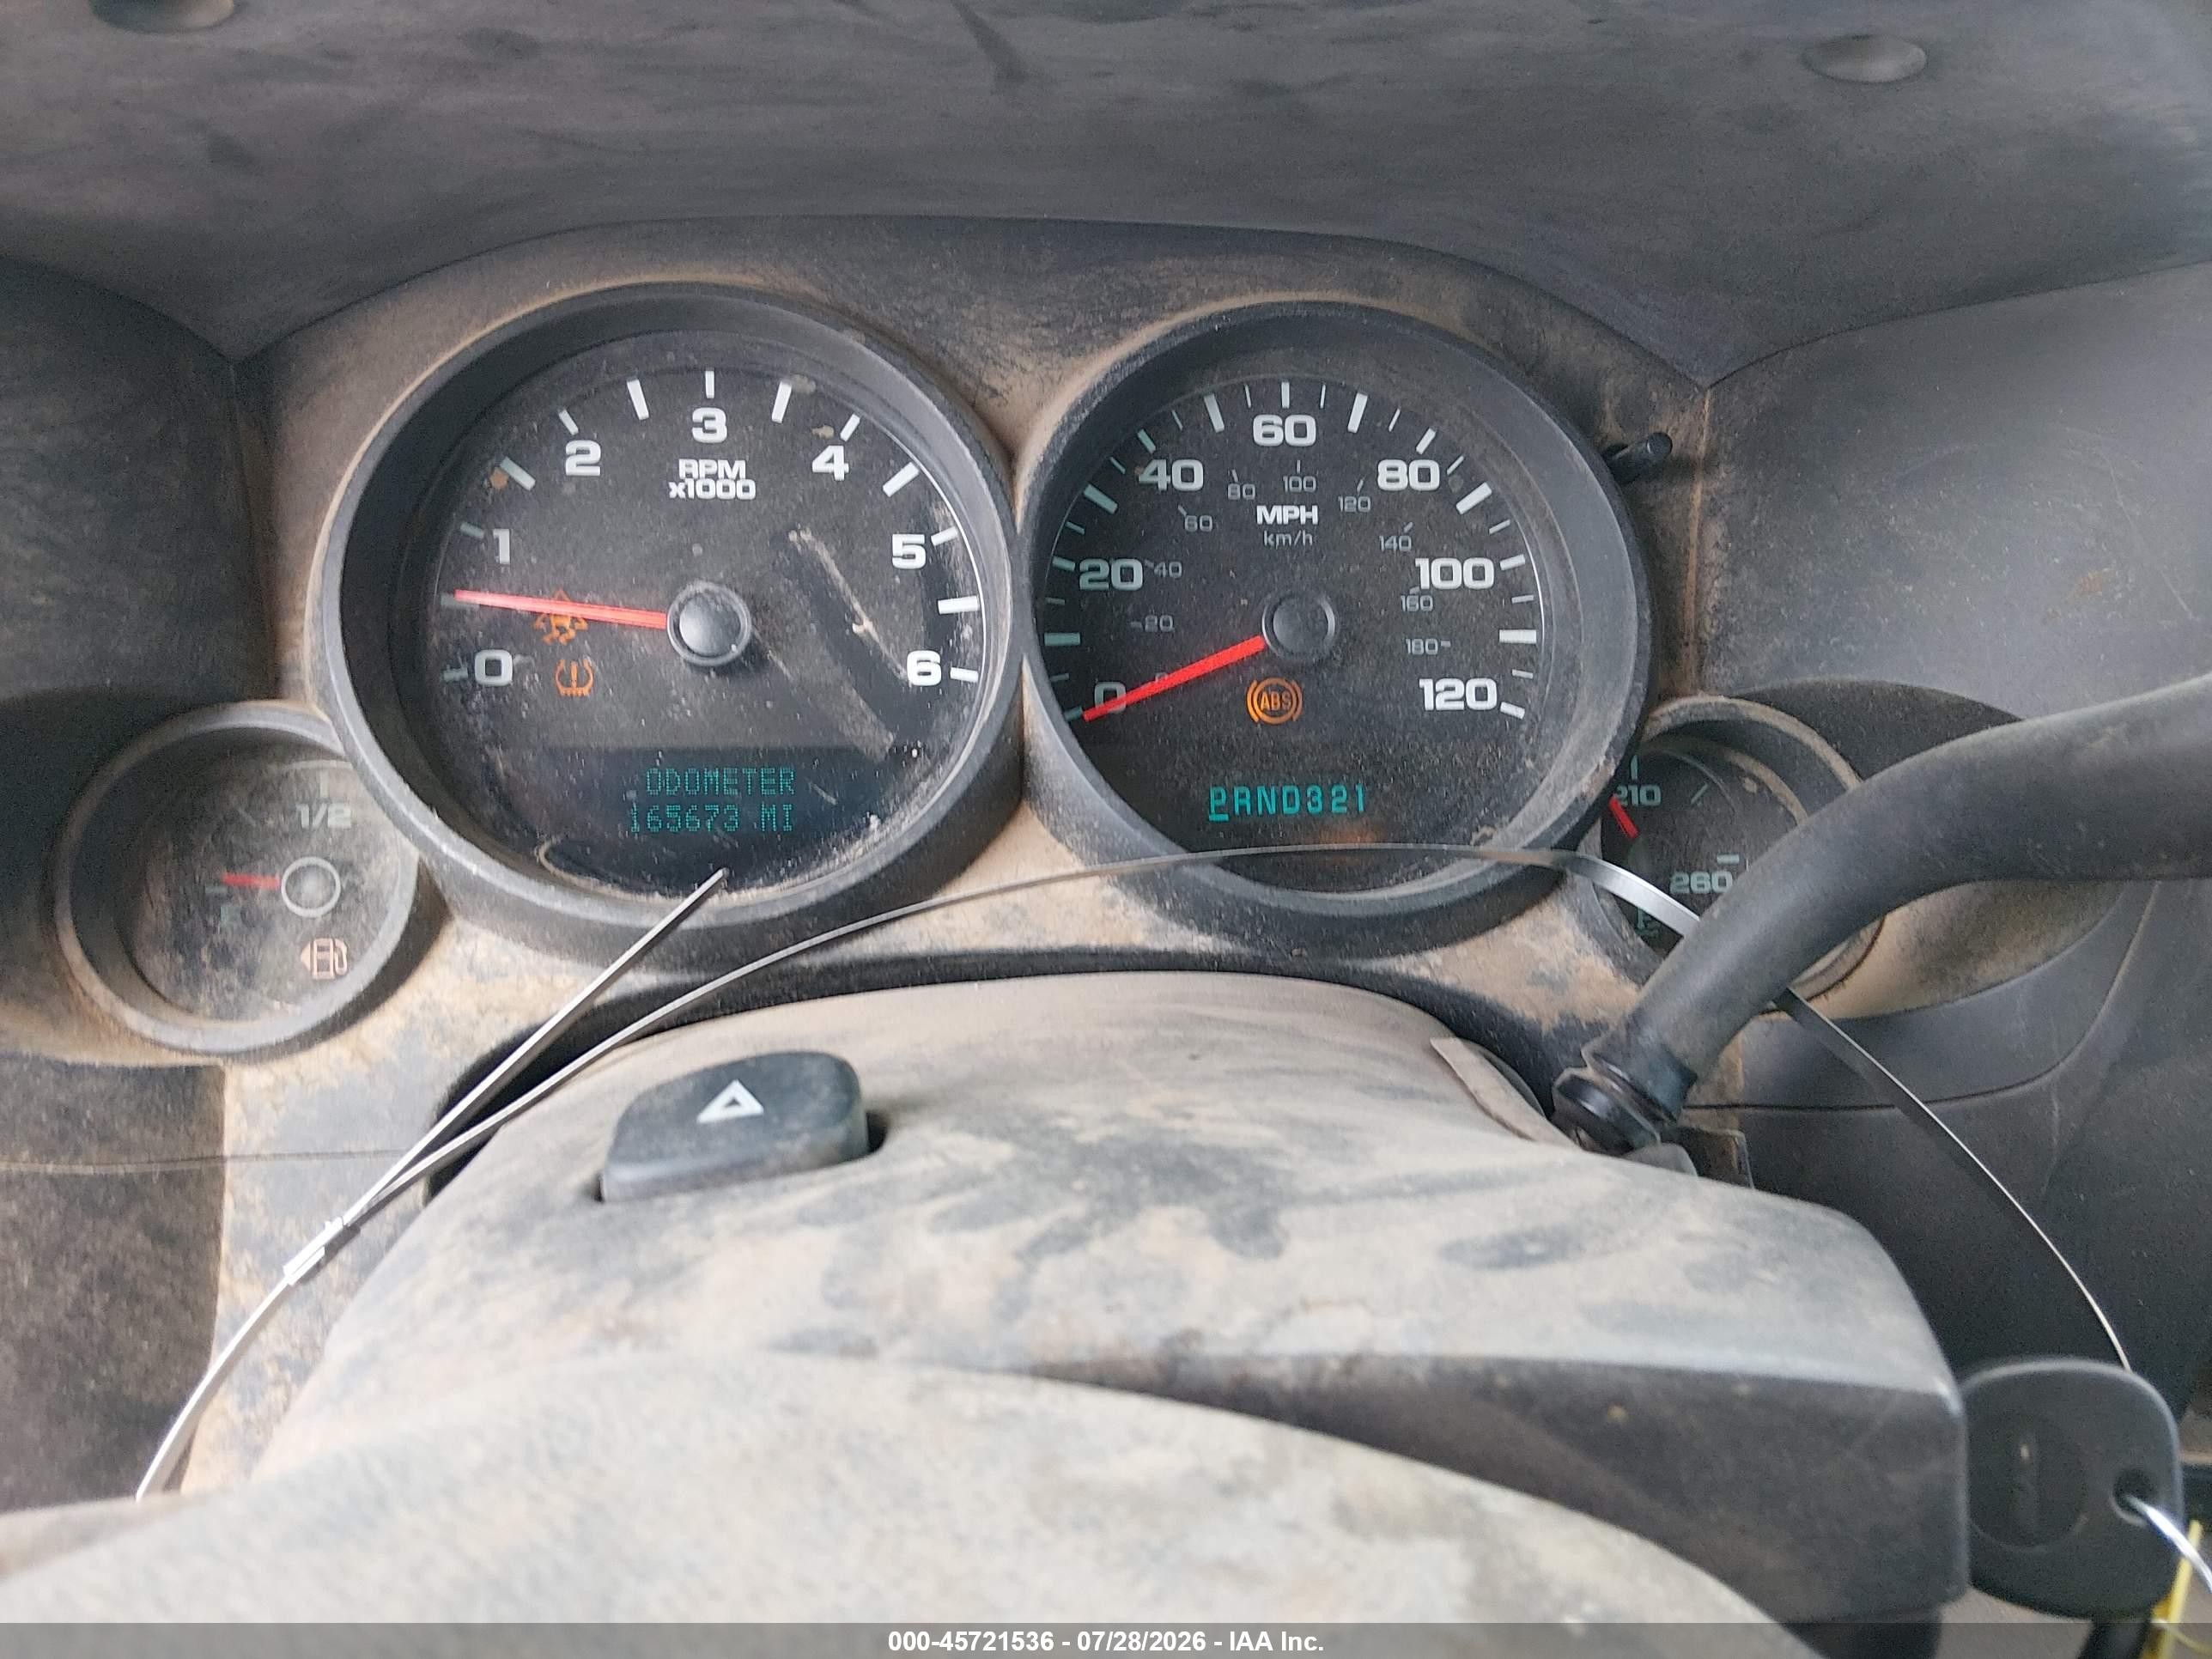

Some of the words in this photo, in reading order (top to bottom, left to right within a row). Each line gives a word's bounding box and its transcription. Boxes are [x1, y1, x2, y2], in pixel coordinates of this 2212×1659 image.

[691, 408, 728, 443] 3
[1253, 414, 1316, 447] 60
[565, 440, 601, 477] 2
[678, 459, 746, 480] RPM
[811, 446, 848, 480] 4
[1139, 459, 1204, 491] 40
[1283, 476, 1316, 494] 100
[1377, 459, 1440, 492] 80
[668, 479, 756, 500] x1000
[1227, 483, 1256, 501] 80
[1256, 505, 1318, 526] MPH
[1338, 496, 1371, 513] 120
[1184, 515, 1213, 532] 60
[492, 529, 511, 564] 1
[891, 534, 926, 568] 5
[1263, 530, 1313, 547] km/h
[1379, 535, 1413, 552] 140
[1079, 559, 1143, 591] 20
[1153, 562, 1182, 578] 40
[1415, 557, 1495, 590] 100
[1401, 594, 1434, 612] 160
[1144, 616, 1174, 632] 20
[1406, 638, 1439, 655] 180
[474, 650, 513, 685] 0
[907, 651, 942, 685] 6
[1094, 681, 1127, 714] 0
[1260, 690, 1291, 711] ABS
[1419, 678, 1498, 711] 120
[646, 767, 795, 797] ODOMETER
[1615, 783, 1662, 807] 210
[295, 803, 352, 830] 1/2
[630, 802, 739, 834] 165673
[761, 803, 793, 833] MI
[1669, 871, 1733, 894] 260
